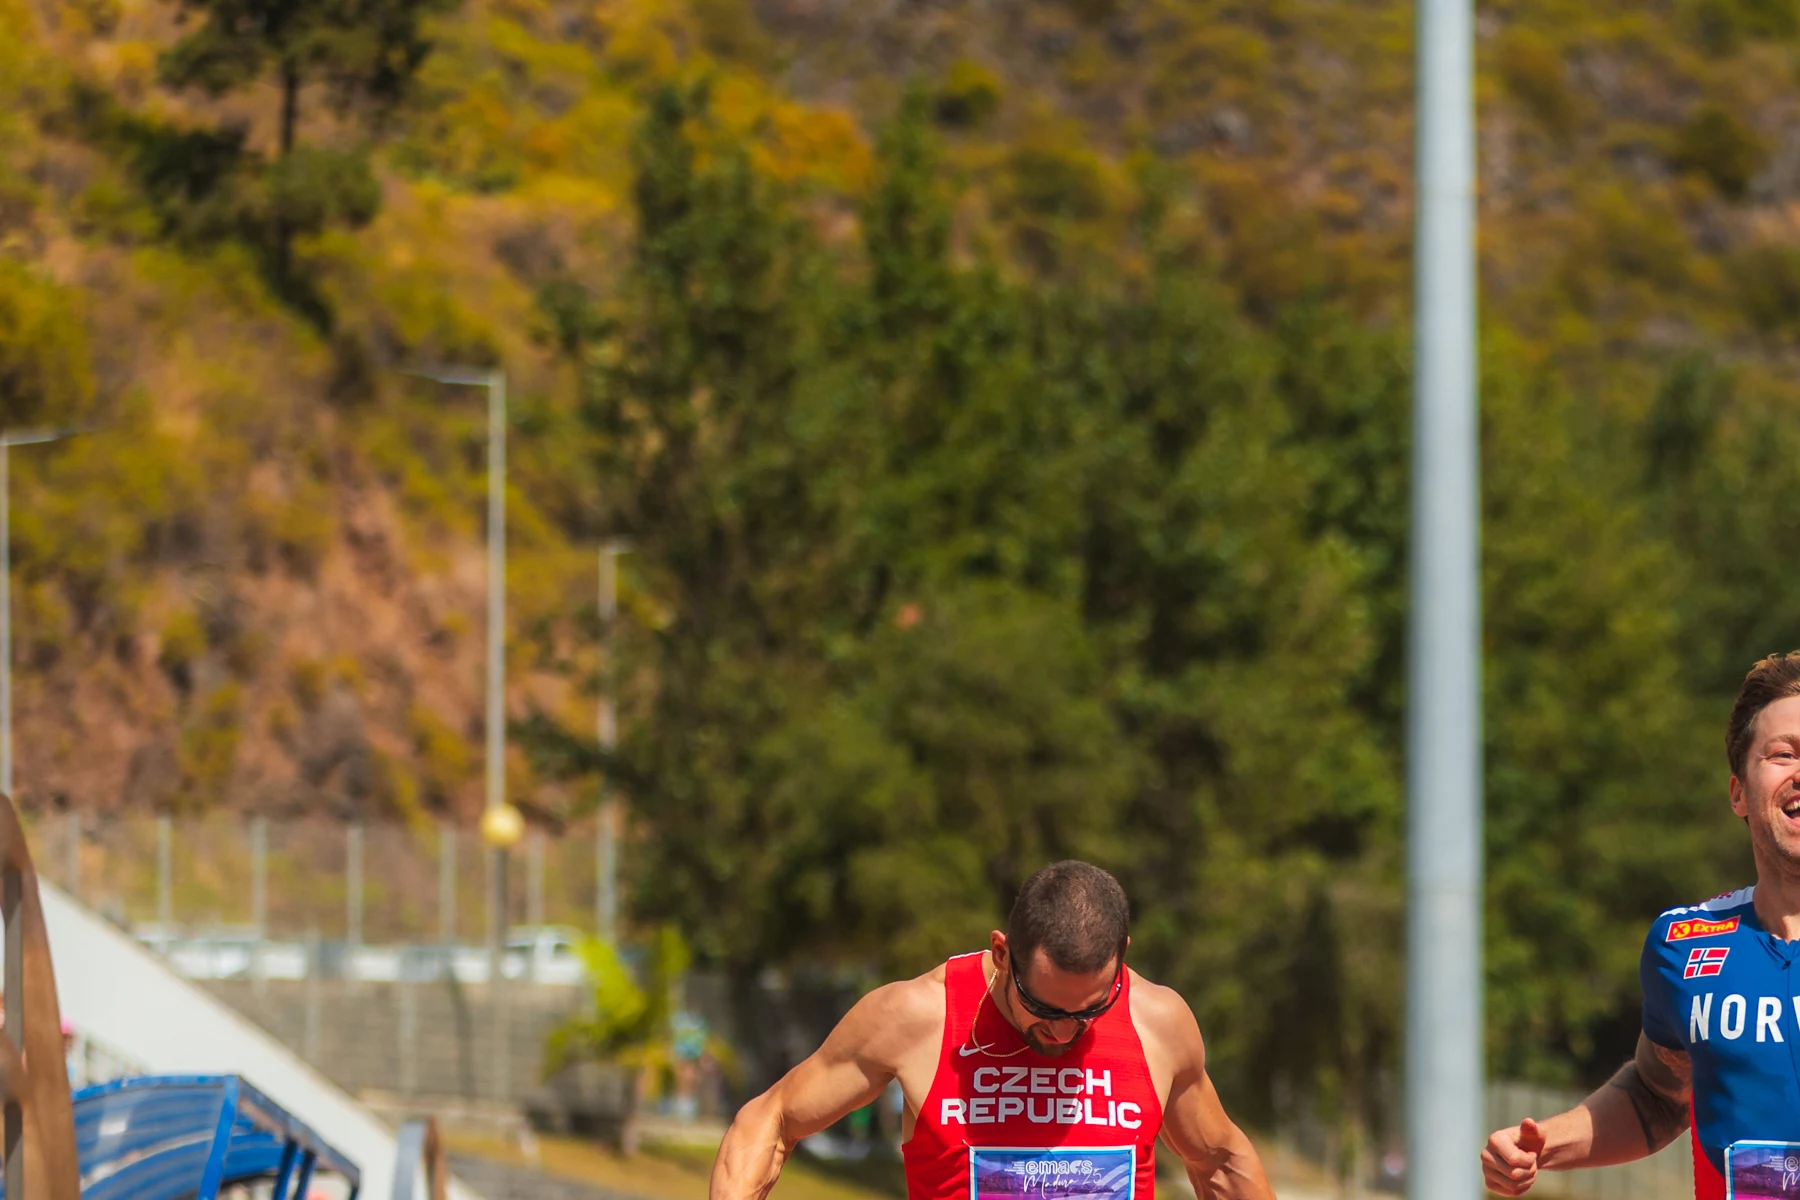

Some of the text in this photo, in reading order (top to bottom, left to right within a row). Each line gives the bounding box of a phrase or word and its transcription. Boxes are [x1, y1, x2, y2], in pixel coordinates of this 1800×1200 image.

[1692, 921, 1735, 933] EXTRA
[973, 1066, 1112, 1096] CZECH
[941, 1098, 1142, 1129] REPUBLIC
[1026, 1160, 1092, 1174] emacs
